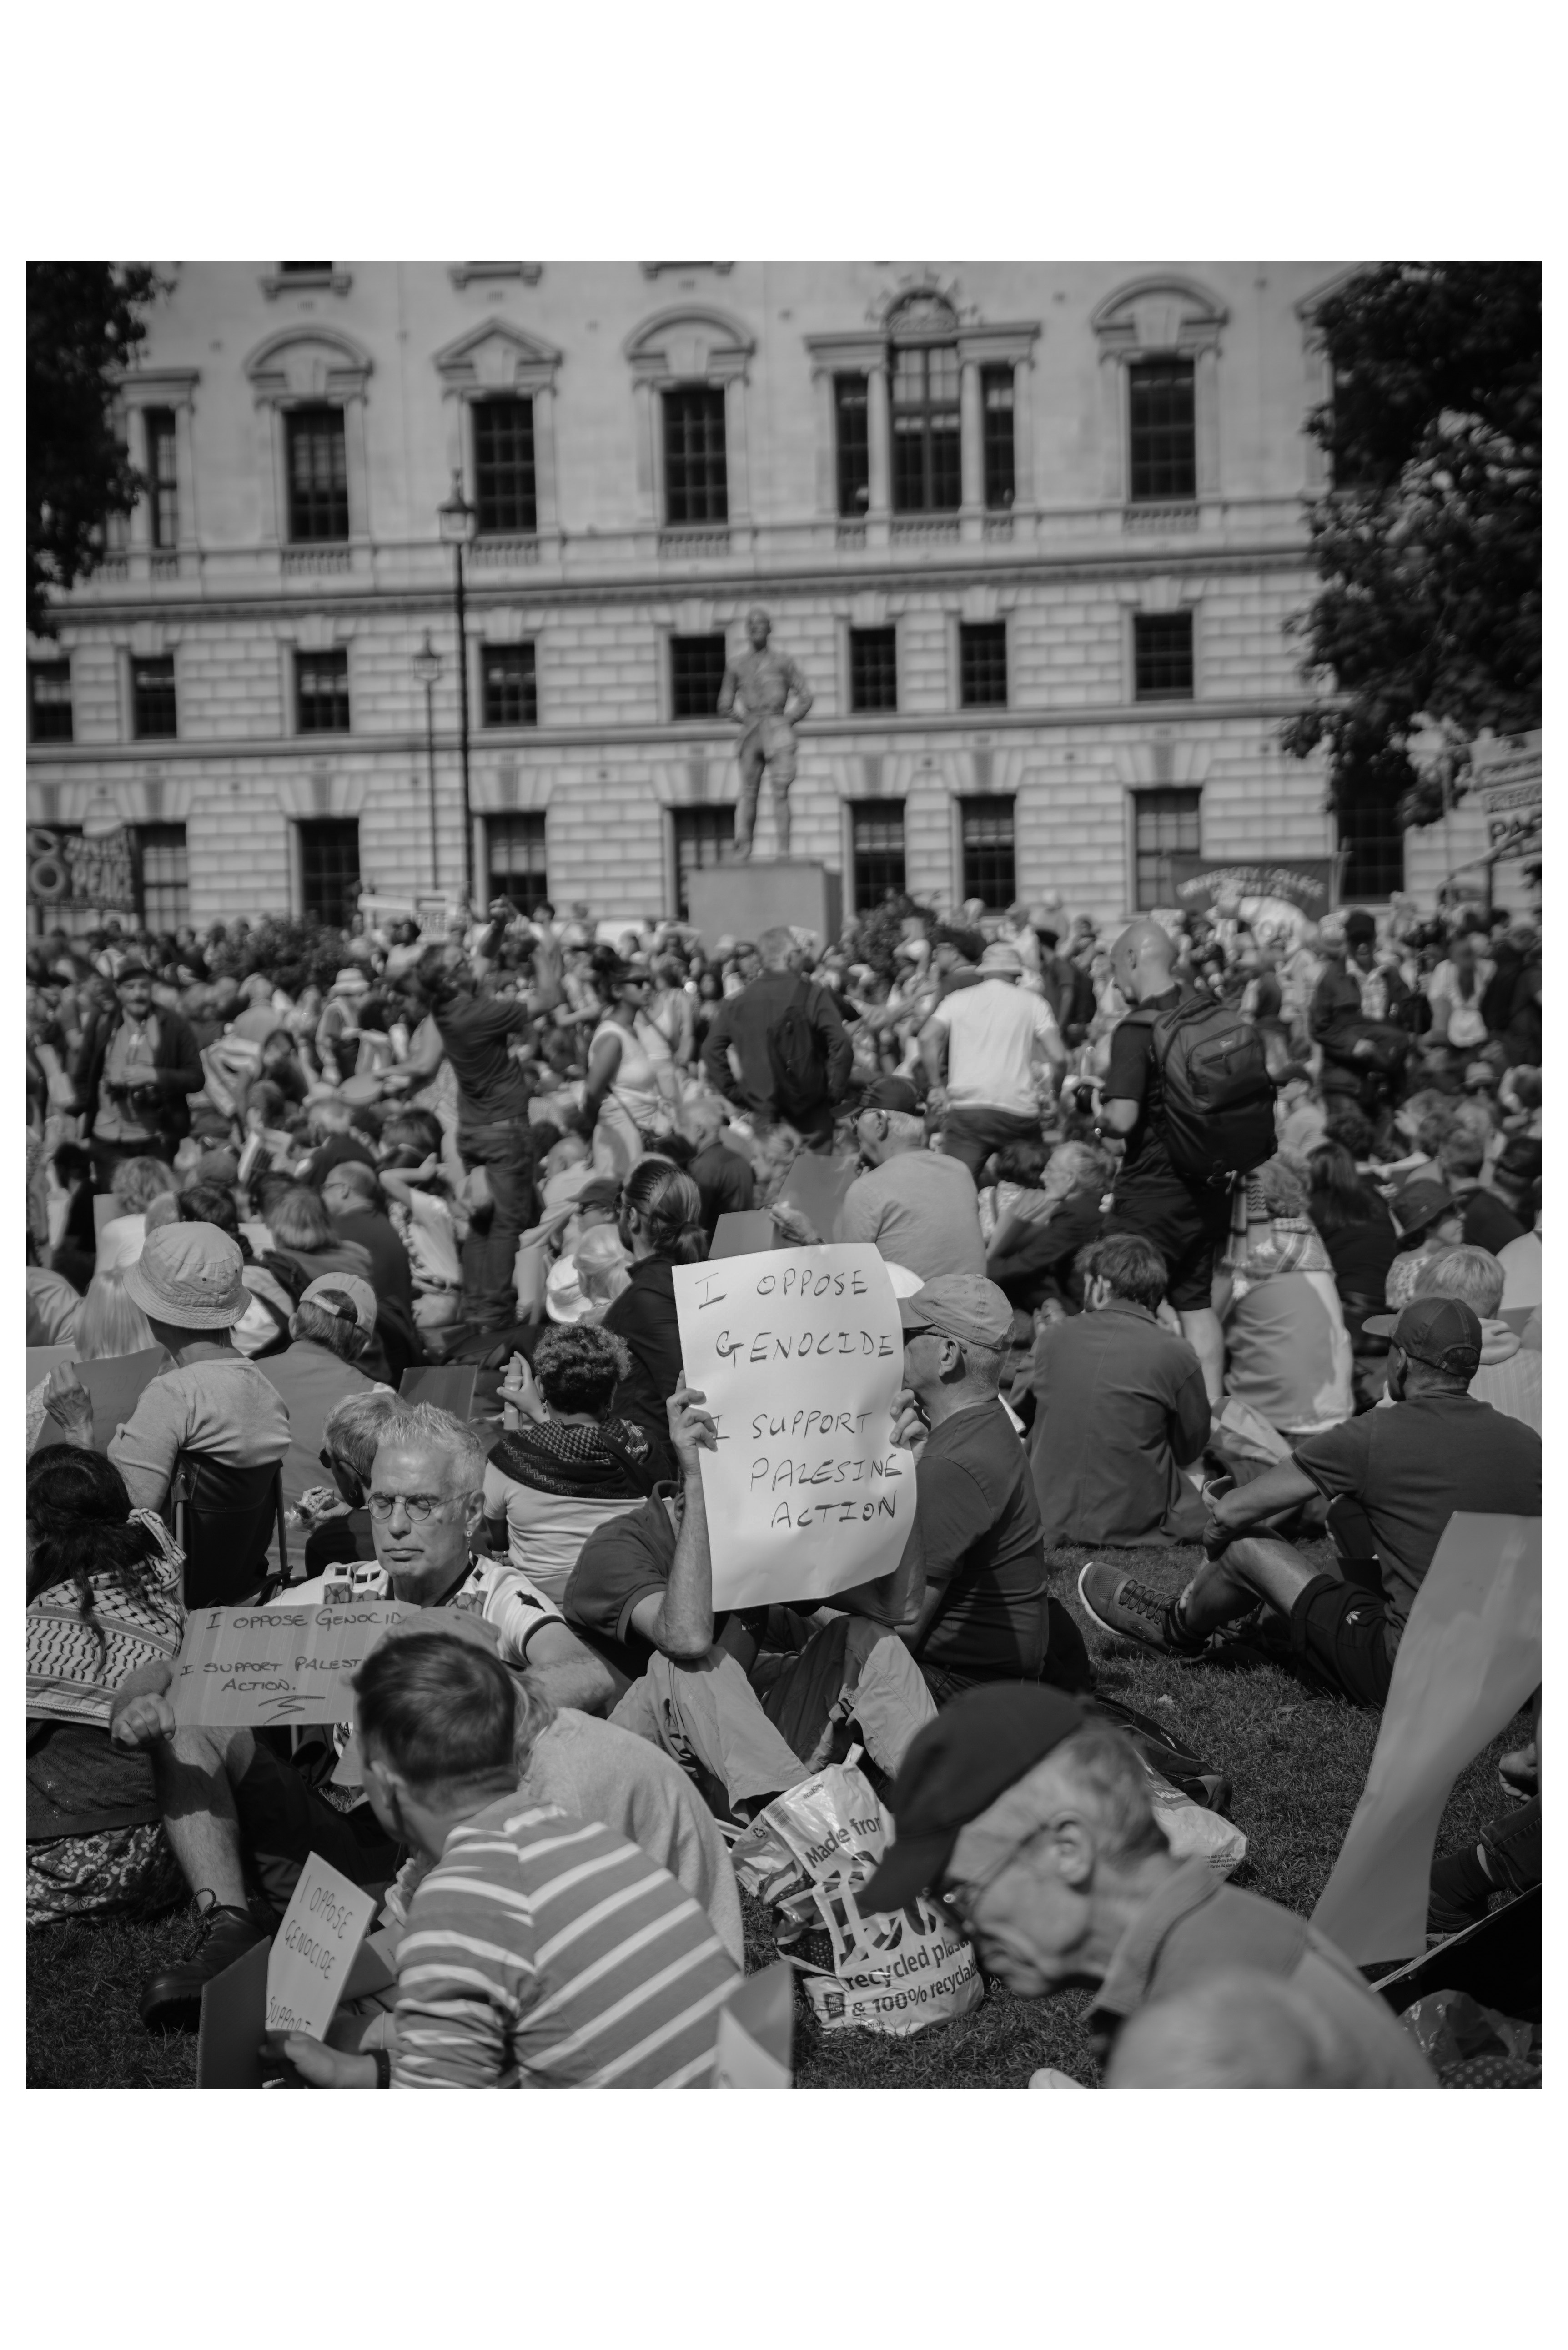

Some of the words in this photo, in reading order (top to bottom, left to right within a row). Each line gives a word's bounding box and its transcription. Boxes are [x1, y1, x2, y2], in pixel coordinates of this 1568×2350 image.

[694, 1272, 728, 1309] I
[756, 1268, 869, 1297] OPPOSE
[715, 1330, 895, 1367] GENOCIDE
[711, 1414, 730, 1441] I
[752, 1410, 873, 1439] SUPPORT
[749, 1454, 903, 1492] PALESINE
[771, 1489, 898, 1529] ACTION
[206, 1612, 225, 1629] I
[232, 1613, 308, 1629] OPPOSE
[315, 1608, 402, 1632] GENOCID
[180, 1664, 194, 1677] I
[203, 1662, 283, 1673] SUPPORT
[294, 1656, 363, 1672] PALEST
[221, 1677, 296, 1692] ACTION.
[804, 1828, 851, 1869] Made
[299, 1874, 311, 1903] I
[309, 1887, 353, 1939] OPPOSE
[284, 1919, 335, 1979] GENOCIDE
[844, 1944, 930, 1991] recycled
[851, 2002, 867, 2016] &
[871, 1985, 927, 2014] 100%
